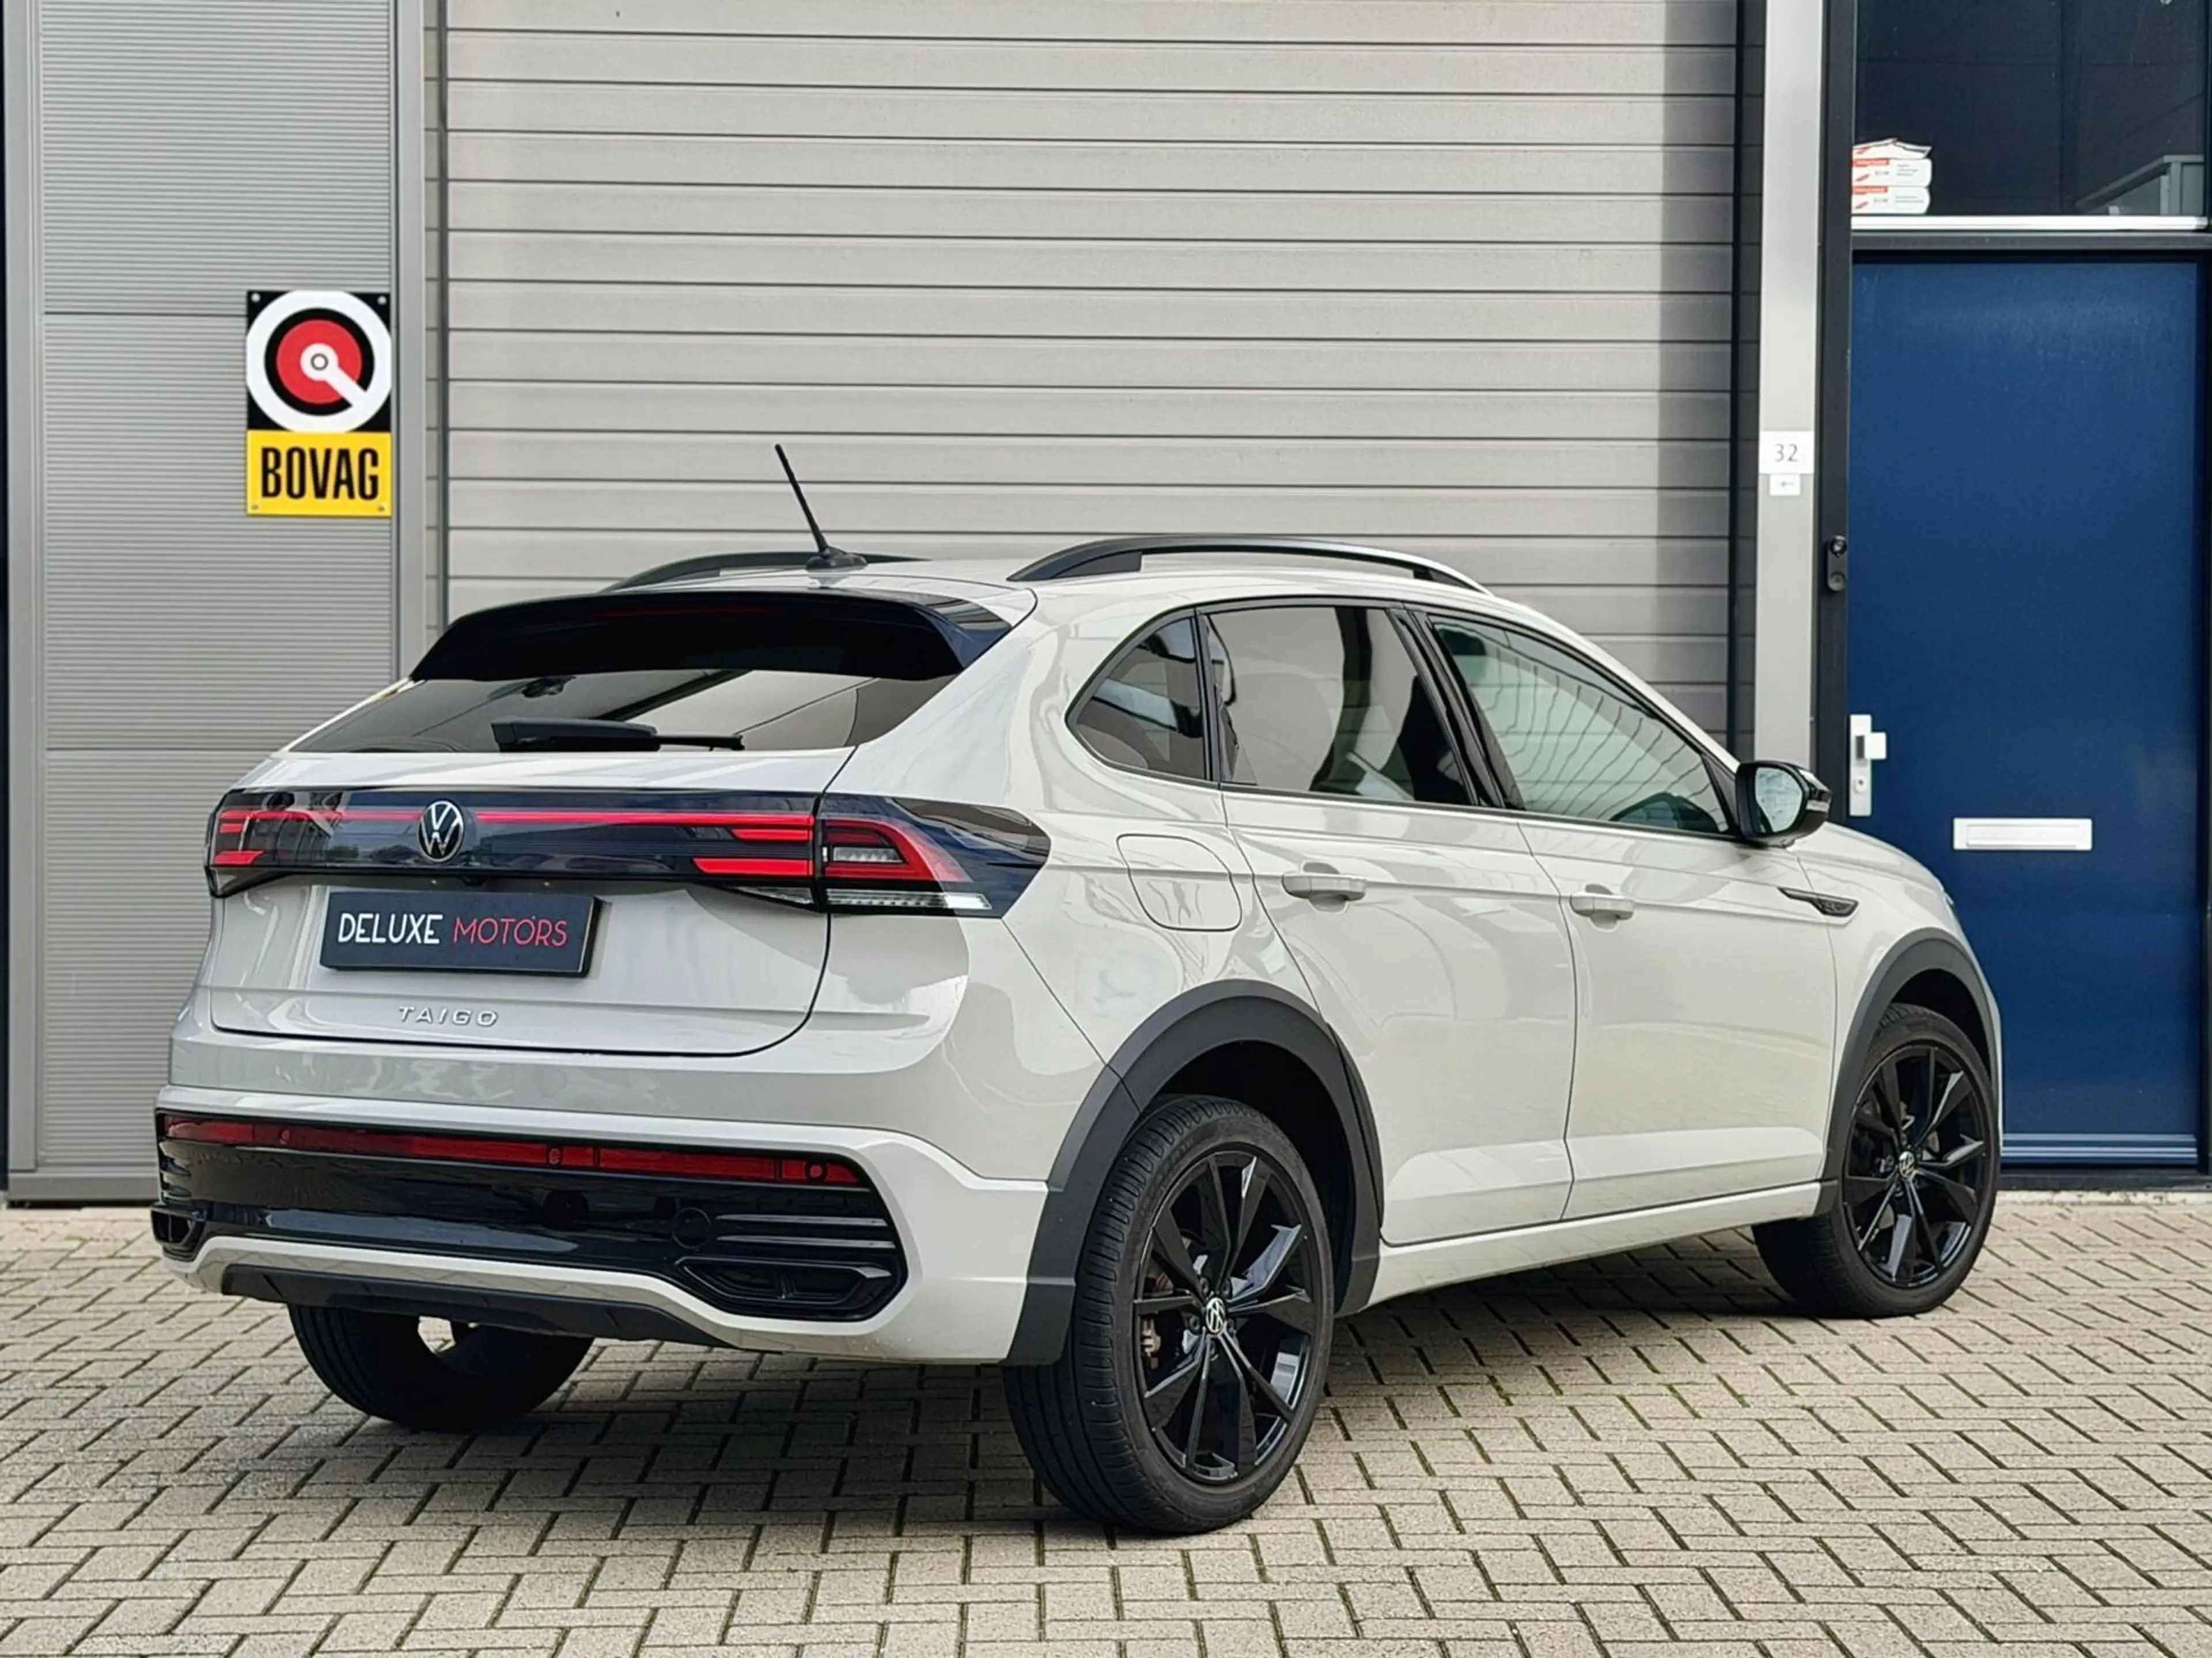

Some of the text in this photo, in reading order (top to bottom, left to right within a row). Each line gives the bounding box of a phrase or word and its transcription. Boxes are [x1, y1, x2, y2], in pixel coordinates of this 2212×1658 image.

[1774, 442, 1799, 463] 32
[261, 446, 379, 501] BOVAG
[338, 912, 567, 947] DELUXE MOTORS
[398, 1006, 499, 1027] TAIGO
